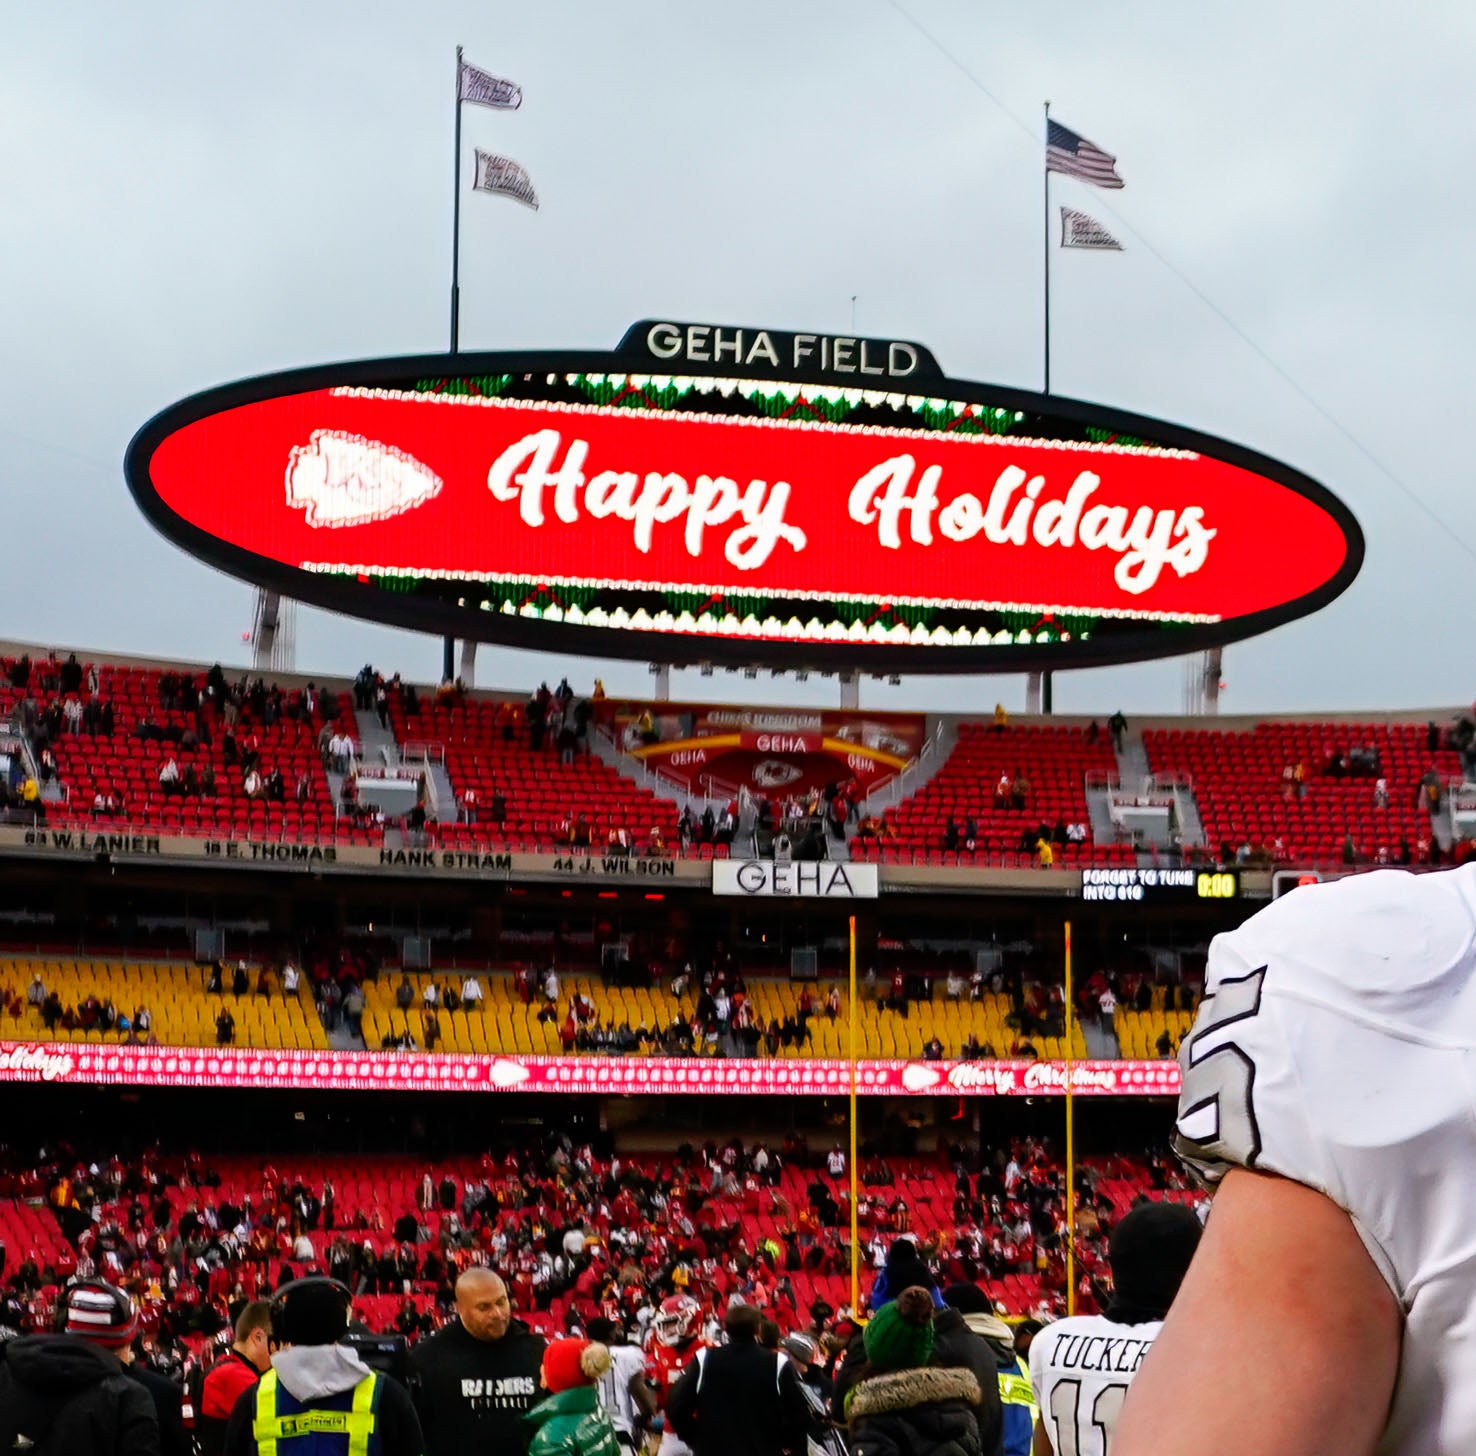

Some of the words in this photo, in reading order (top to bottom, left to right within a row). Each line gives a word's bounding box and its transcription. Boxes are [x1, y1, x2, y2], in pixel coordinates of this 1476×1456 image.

[647, 322, 779, 366] GEHA
[793, 334, 918, 378] FIELD
[487, 430, 806, 570] Happy
[848, 454, 1217, 595] Holidays
[757, 735, 807, 754] GEHA
[670, 749, 706, 766] GEHA
[847, 752, 875, 773] GEHA
[380, 849, 437, 867] HANK
[736, 862, 857, 896] GEHA
[1197, 873, 1235, 898] 0:00
